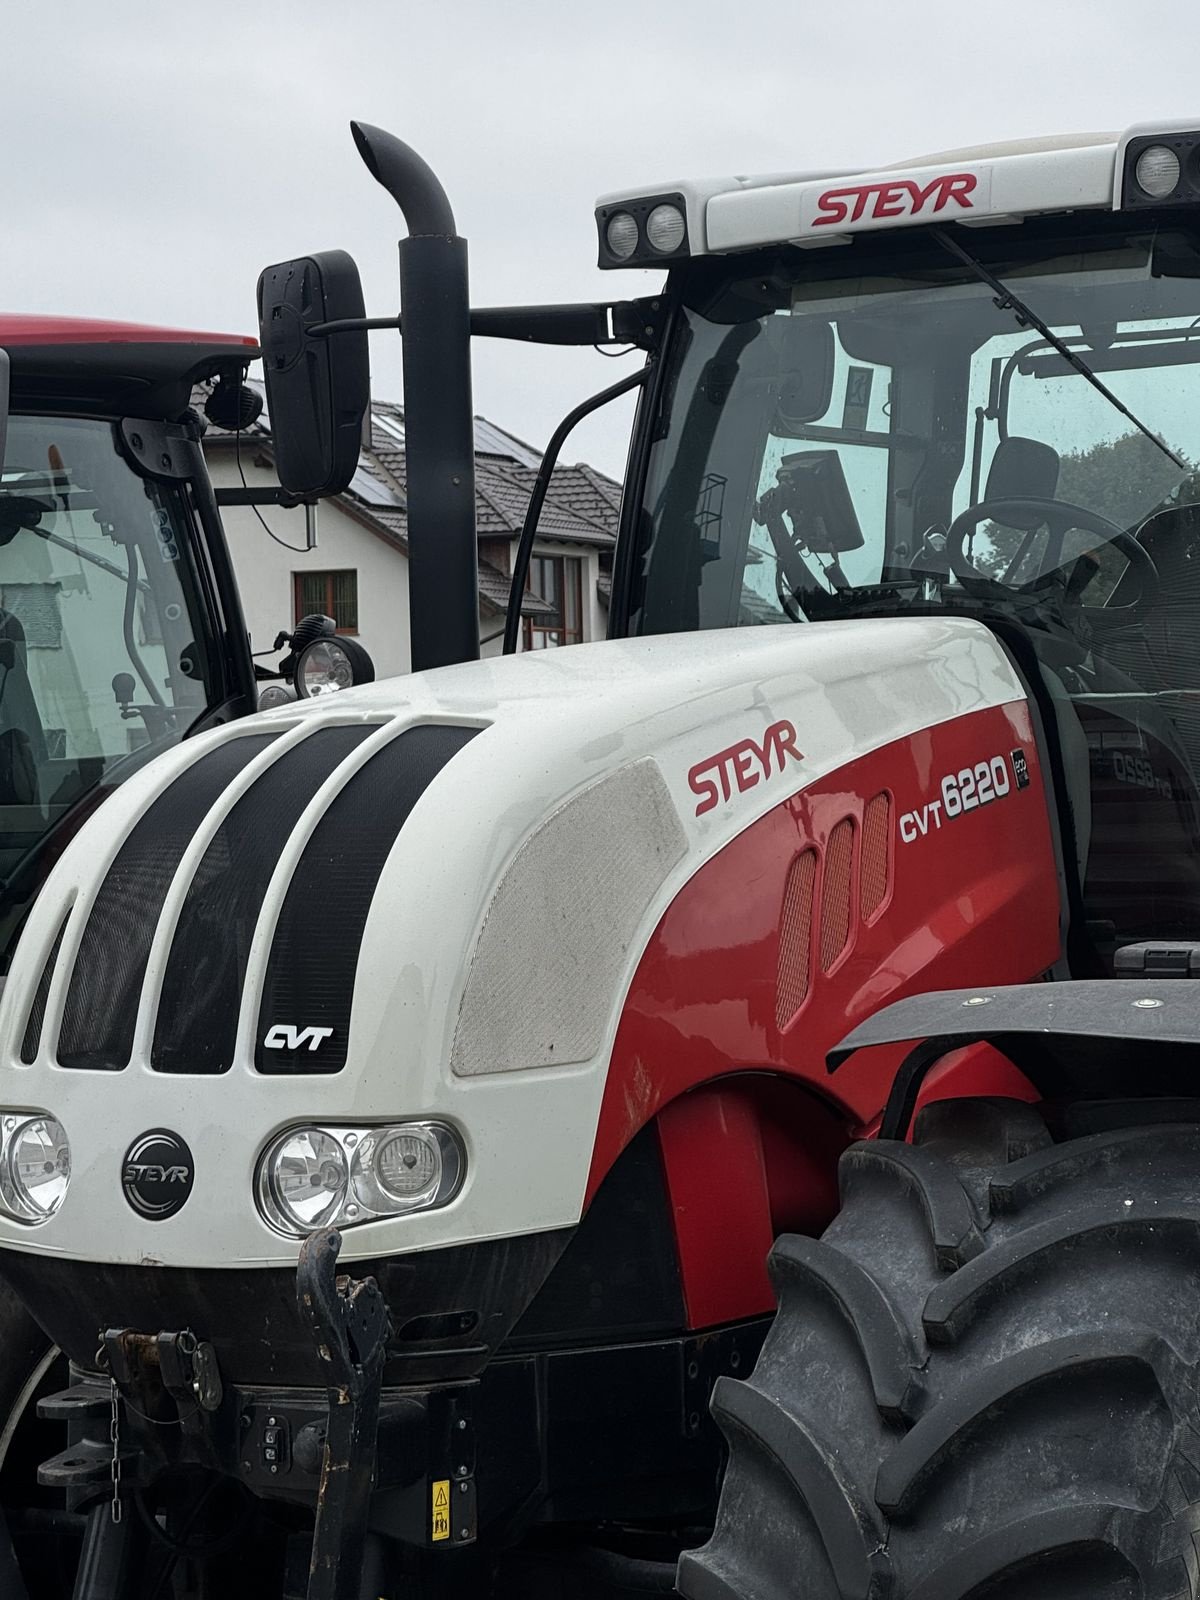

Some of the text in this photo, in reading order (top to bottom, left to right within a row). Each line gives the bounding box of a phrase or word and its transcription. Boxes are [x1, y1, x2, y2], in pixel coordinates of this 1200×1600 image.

[812, 174, 977, 226] STEYR
[688, 719, 805, 817] STEYR
[900, 755, 1009, 843] CVT 6220
[264, 1024, 334, 1051] CVT
[123, 1164, 189, 1183] STEYR
